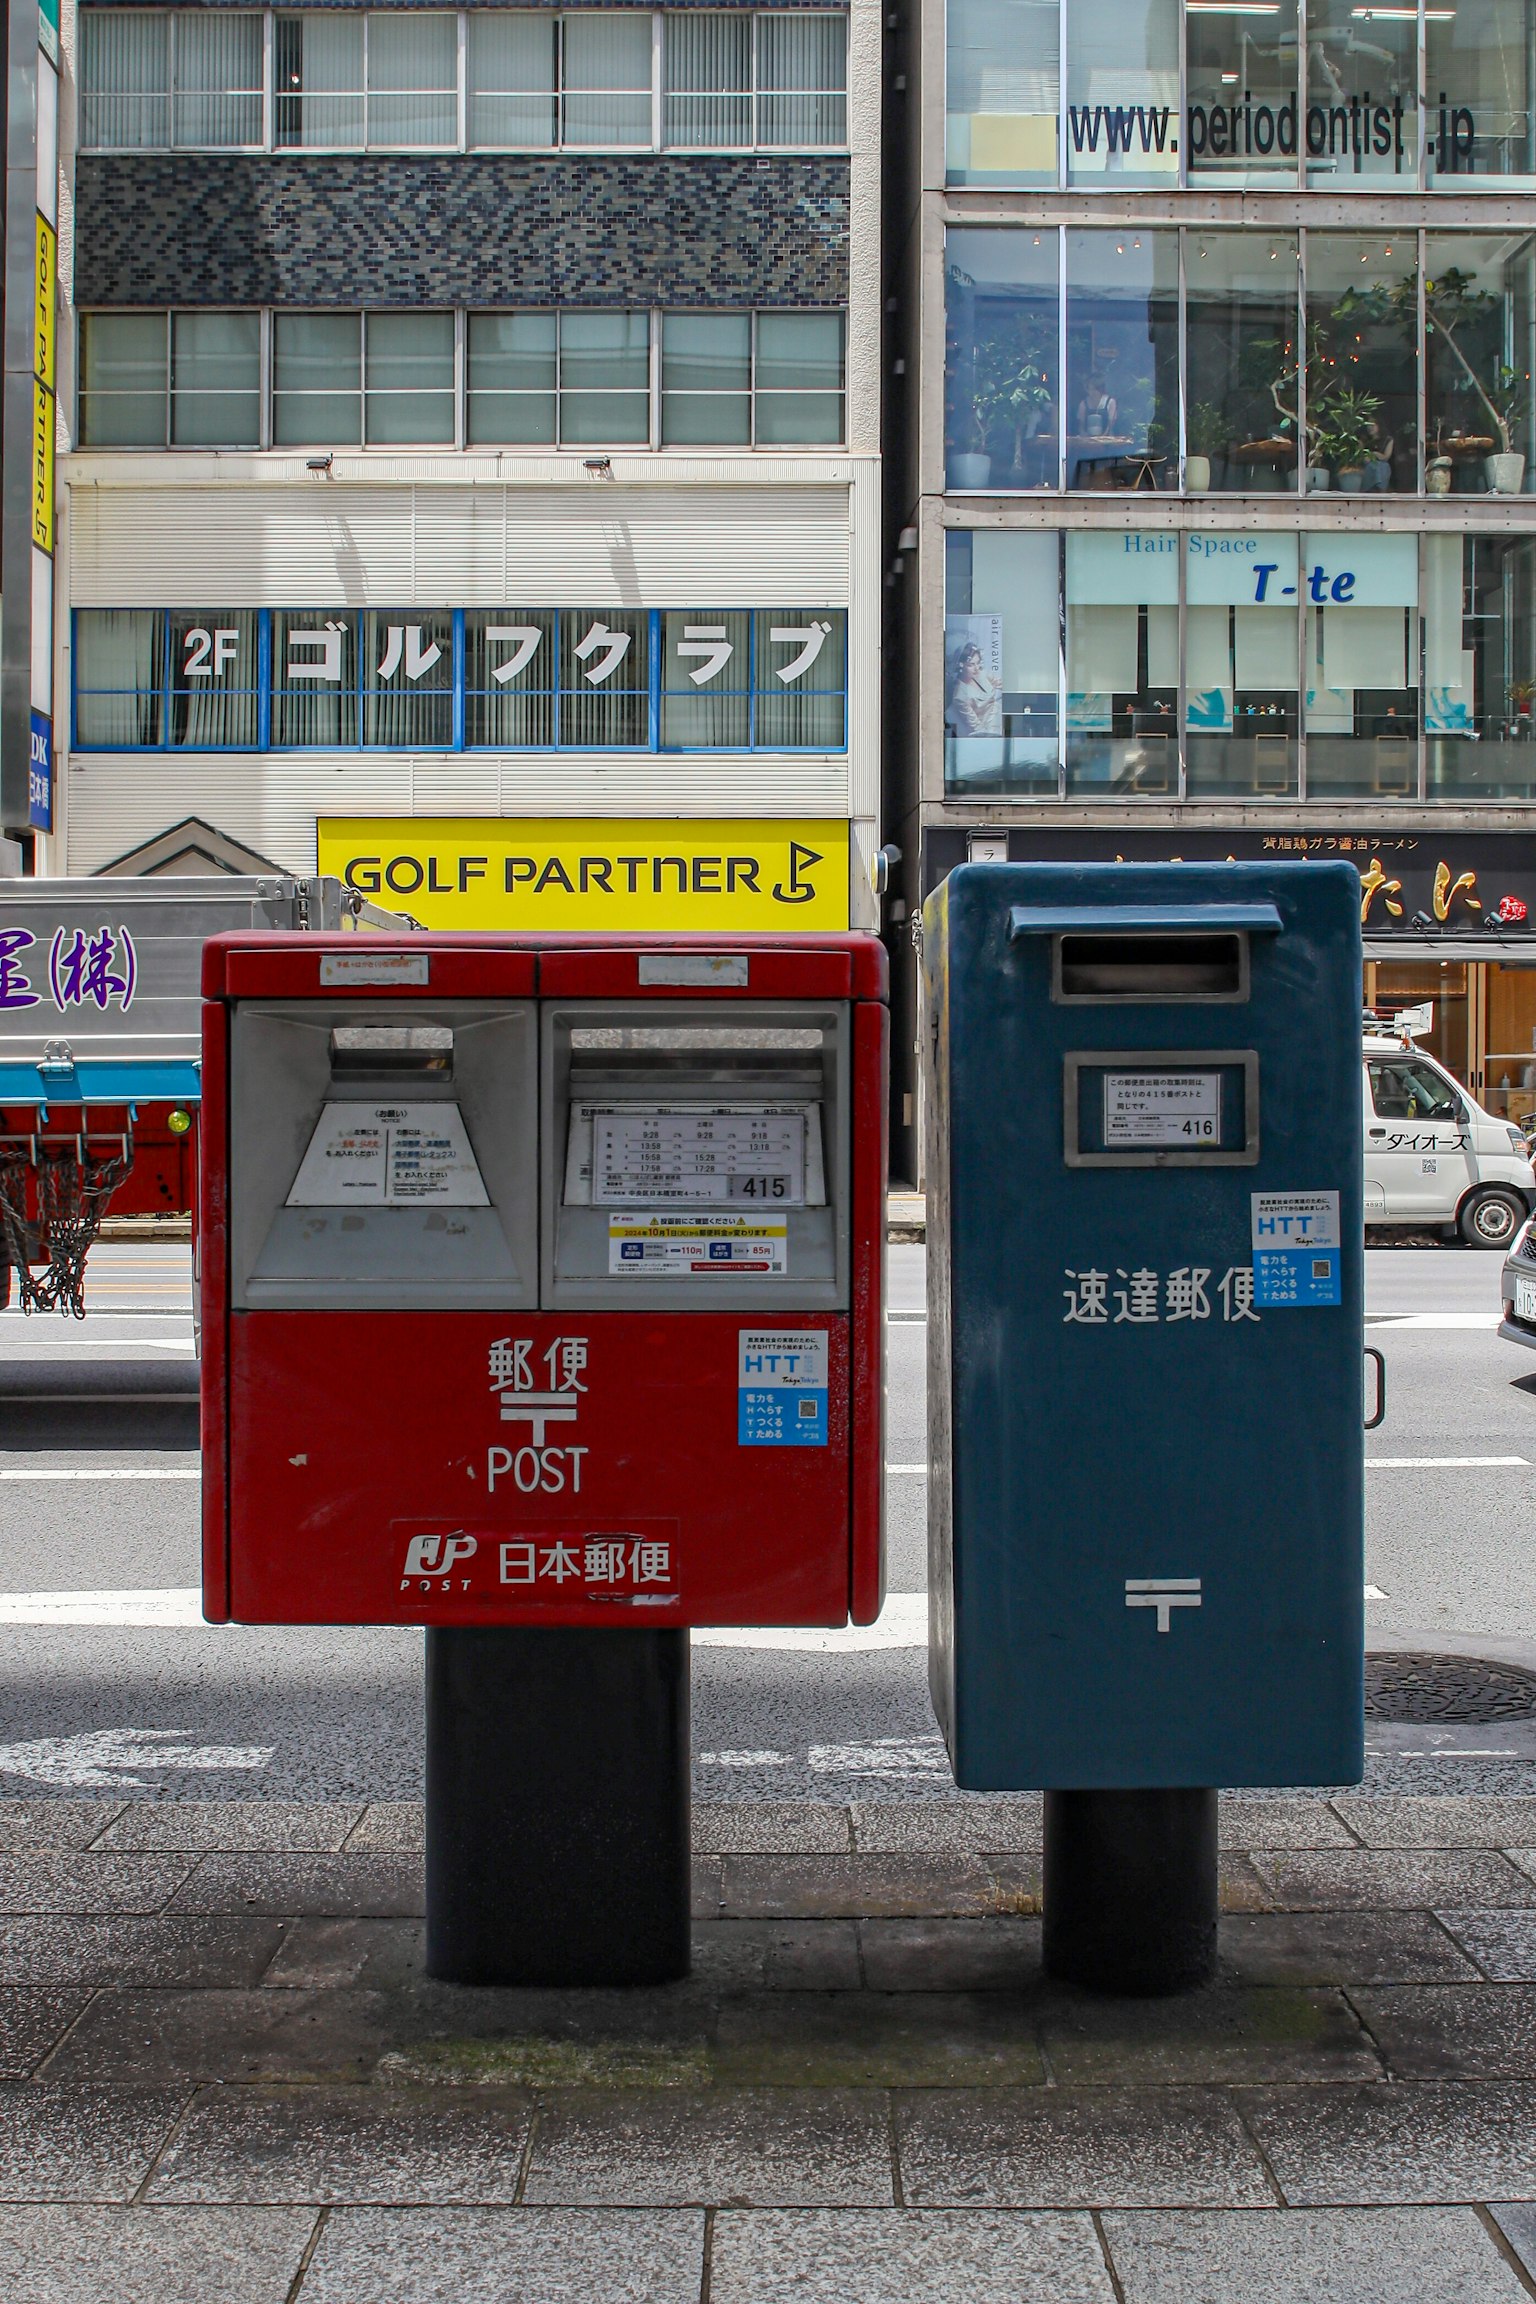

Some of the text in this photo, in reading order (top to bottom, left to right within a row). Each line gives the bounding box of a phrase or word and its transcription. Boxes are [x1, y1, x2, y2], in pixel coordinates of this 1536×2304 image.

[39, 231, 48, 326] GOLF
[1123, 534, 1257, 557] Hair Space
[1253, 564, 1356, 603] T-te
[991, 618, 1000, 671] air wave
[184, 620, 832, 686] 2F ゴルフクラブ
[1262, 836, 1419, 850] 背脂鶏ガラ醤油ラーメン
[344, 857, 488, 893] GOLF
[1182, 1120, 1213, 1135] 416
[643, 1131, 659, 1139] 9:28
[697, 1131, 713, 1139] 9:28
[751, 1132, 768, 1140] 9:18
[1387, 1134, 1471, 1150] ダイオーズ
[640, 1142, 661, 1150] 13:58
[749, 1143, 770, 1151] 13:18
[695, 1165, 716, 1173] 17:28
[743, 1178, 785, 1198] 415
[1258, 1216, 1312, 1235] HTT
[1260, 1256, 1288, 1265] 電力を
[1271, 1267, 1297, 1276] へらす
[1271, 1279, 1297, 1288] つくる
[1063, 1267, 1261, 1323] 速達郵便
[1271, 1291, 1297, 1300] ためる
[488, 1337, 588, 1392] 郵便
[745, 1355, 800, 1373] HTT
[746, 1394, 774, 1403] 電力を
[757, 1406, 783, 1415] へらす
[757, 1418, 783, 1427] つくる
[756, 1430, 783, 1438] ためる
[488, 1447, 589, 1493] POST
[500, 1541, 671, 1584] 日本郵便
[400, 1580, 472, 1591] POST
